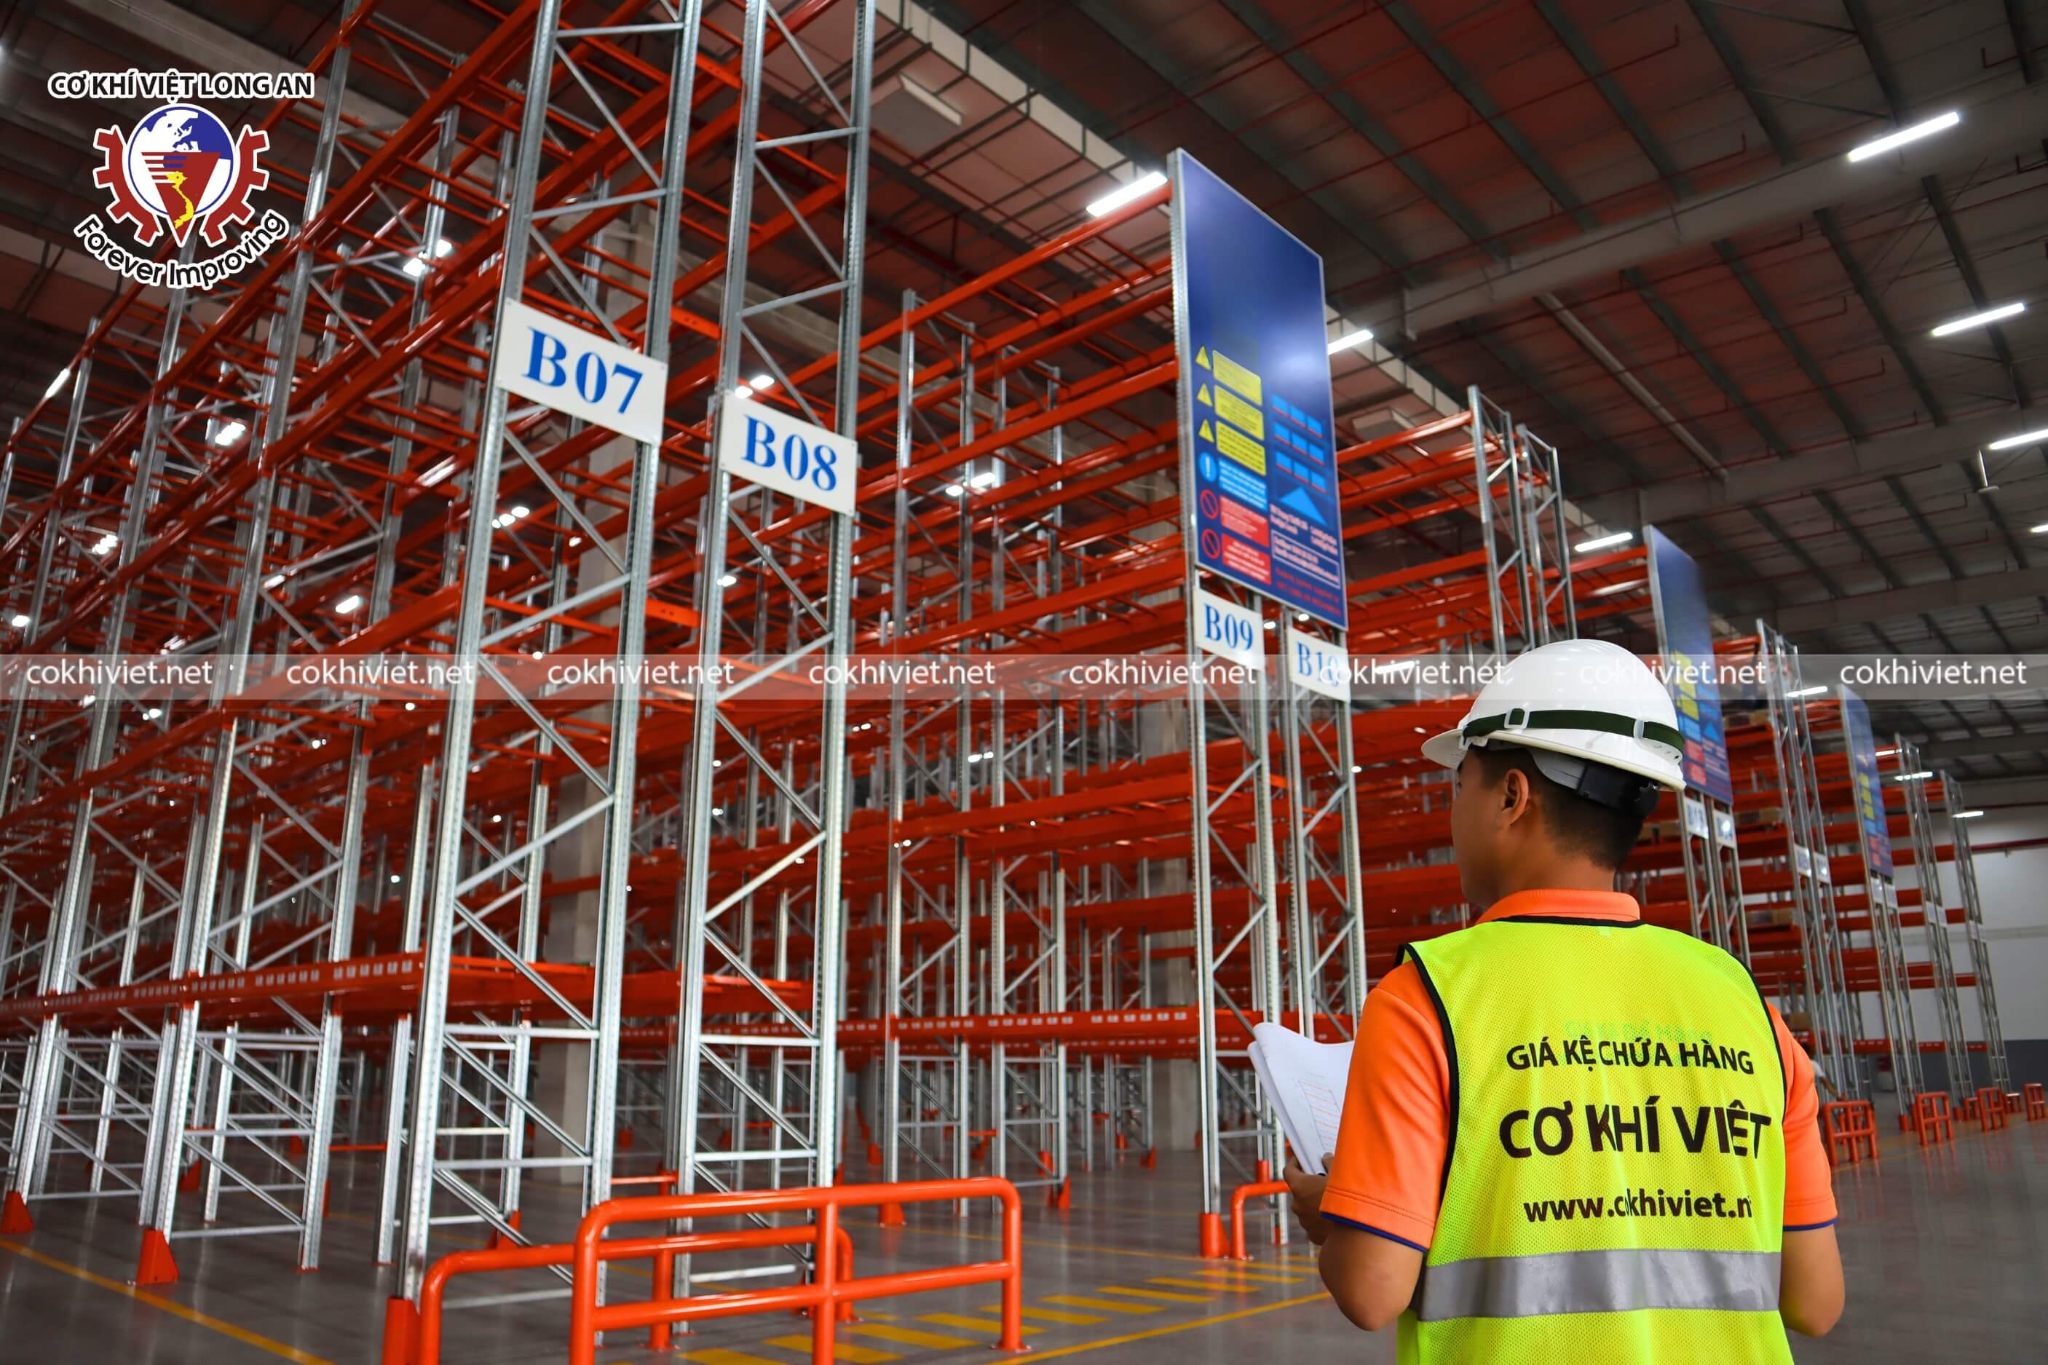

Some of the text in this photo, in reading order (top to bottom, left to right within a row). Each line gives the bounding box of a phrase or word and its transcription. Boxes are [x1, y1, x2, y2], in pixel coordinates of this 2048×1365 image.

[521, 326, 644, 414] B07
[741, 414, 837, 491] B08
[1204, 603, 1254, 650] B09
[1506, 1034, 1754, 1075] GIÁ KỆ CHỨA HÀNG
[1500, 1100, 1574, 1159] CƠ
[1585, 1096, 1661, 1153] KHÍ
